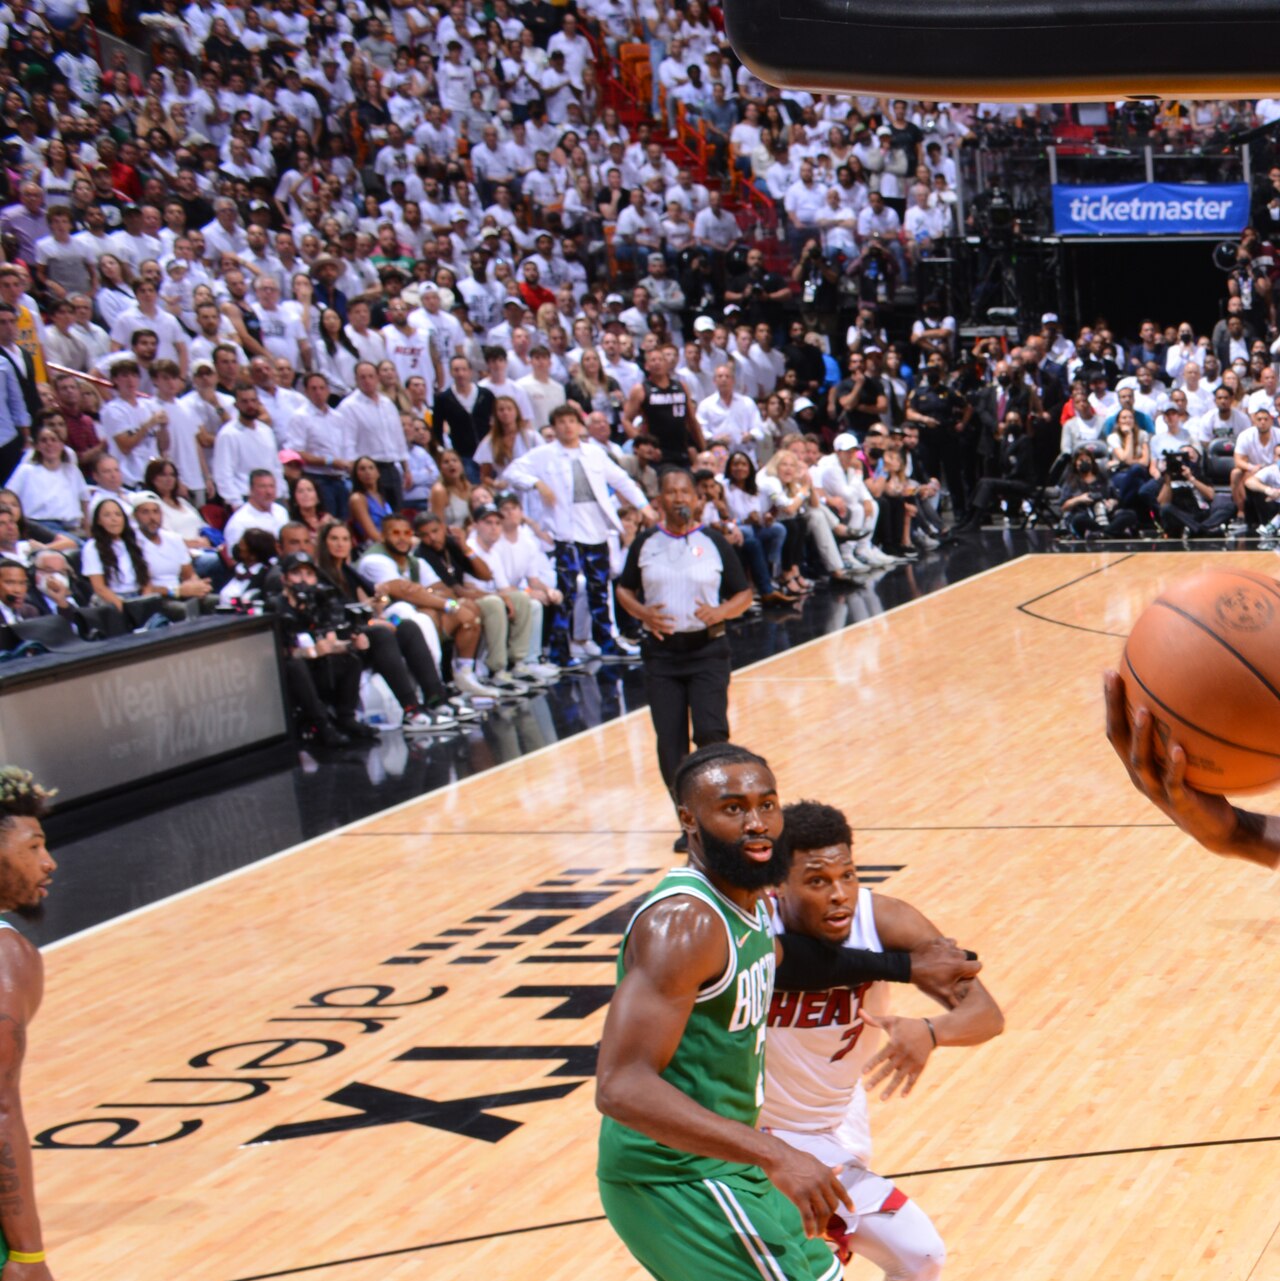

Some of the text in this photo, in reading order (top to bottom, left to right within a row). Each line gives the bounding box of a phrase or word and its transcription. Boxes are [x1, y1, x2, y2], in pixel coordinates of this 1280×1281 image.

[1069, 195, 1233, 222] ticketmaster
[830, 1023, 864, 1063] 7
[31, 984, 449, 1150] arena
